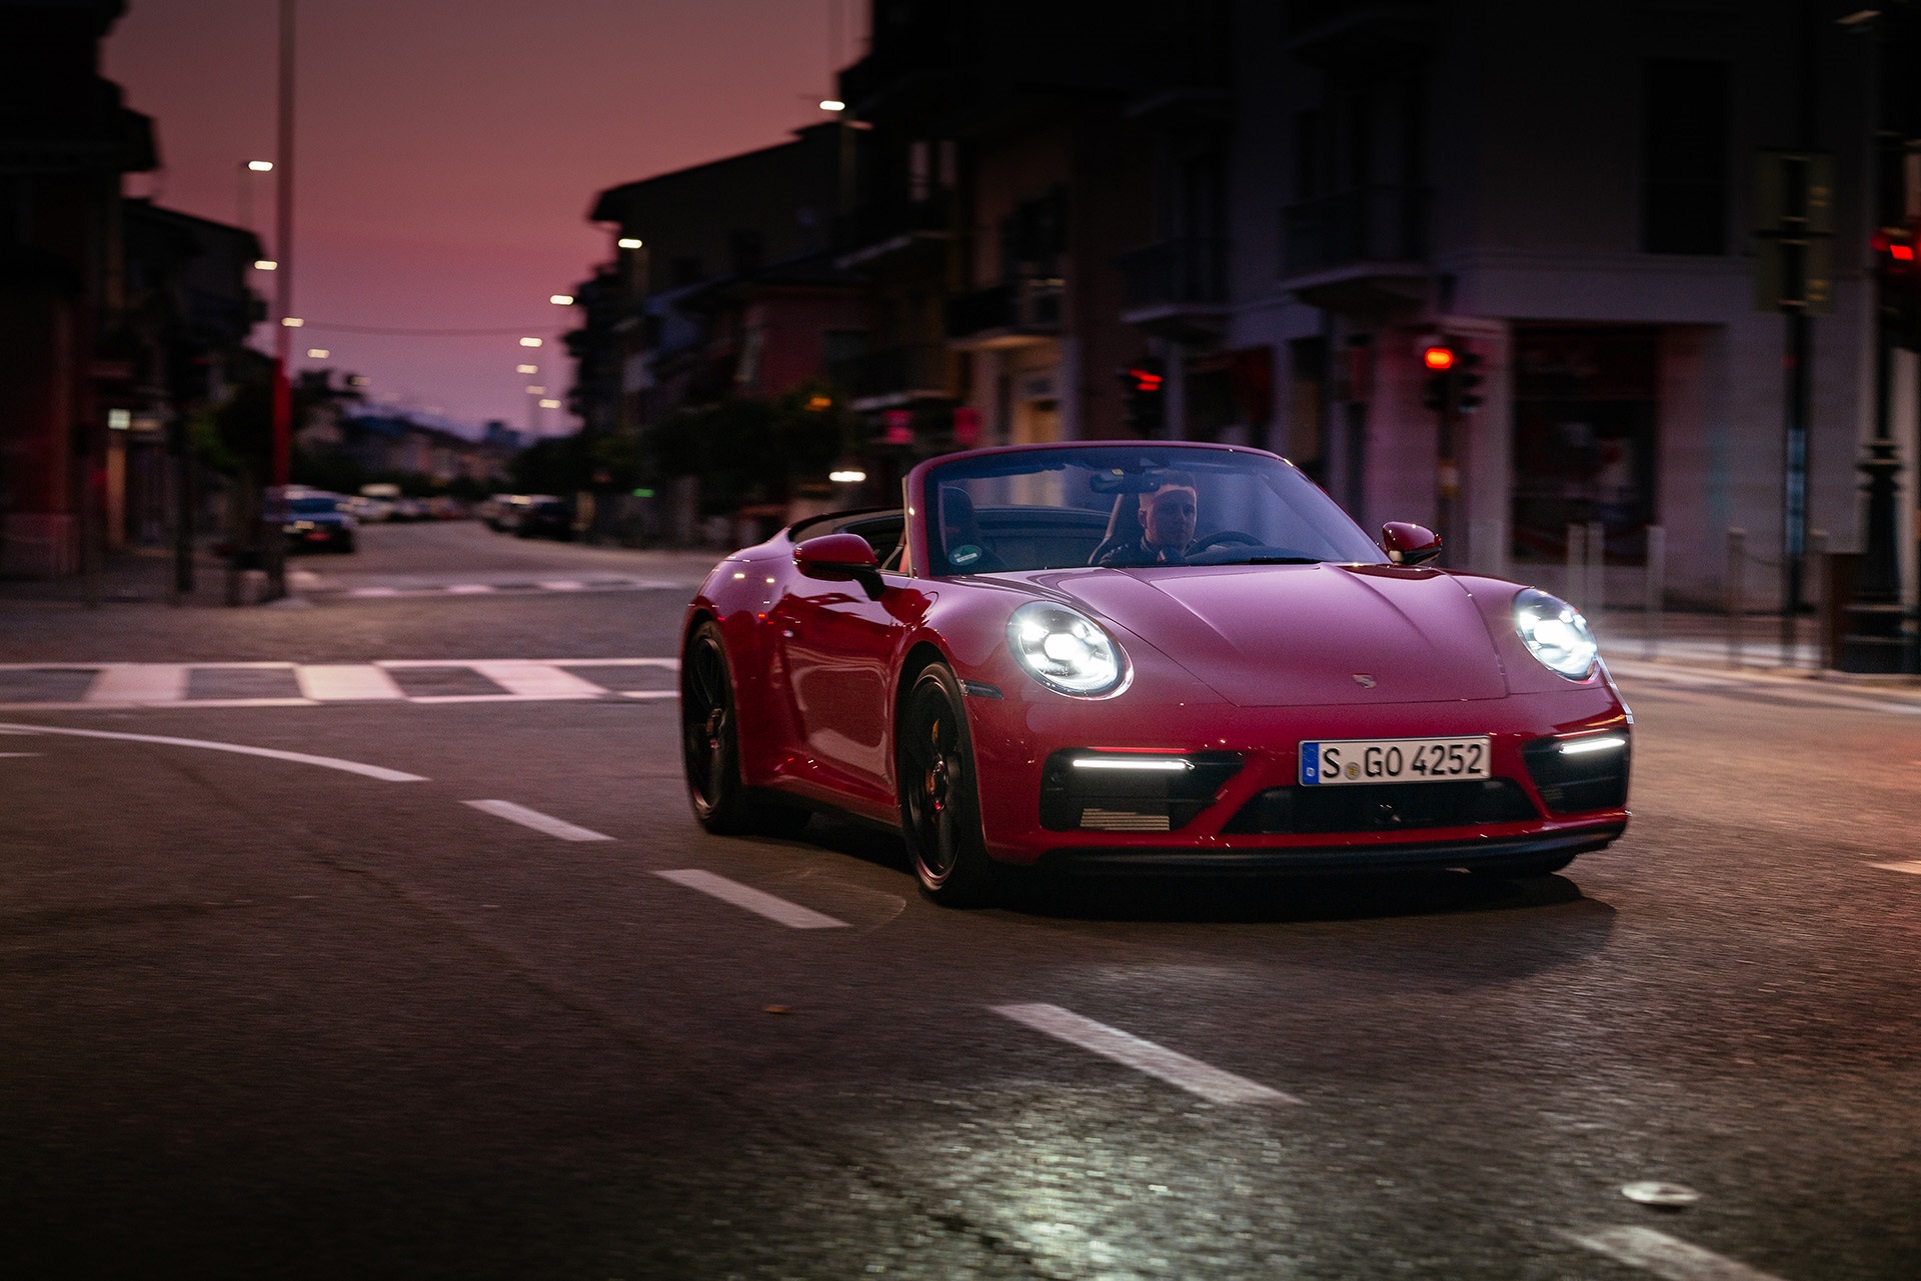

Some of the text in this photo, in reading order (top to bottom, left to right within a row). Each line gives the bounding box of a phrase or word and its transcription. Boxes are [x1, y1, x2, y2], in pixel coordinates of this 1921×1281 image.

[1322, 744, 1482, 778] S GO 4252
